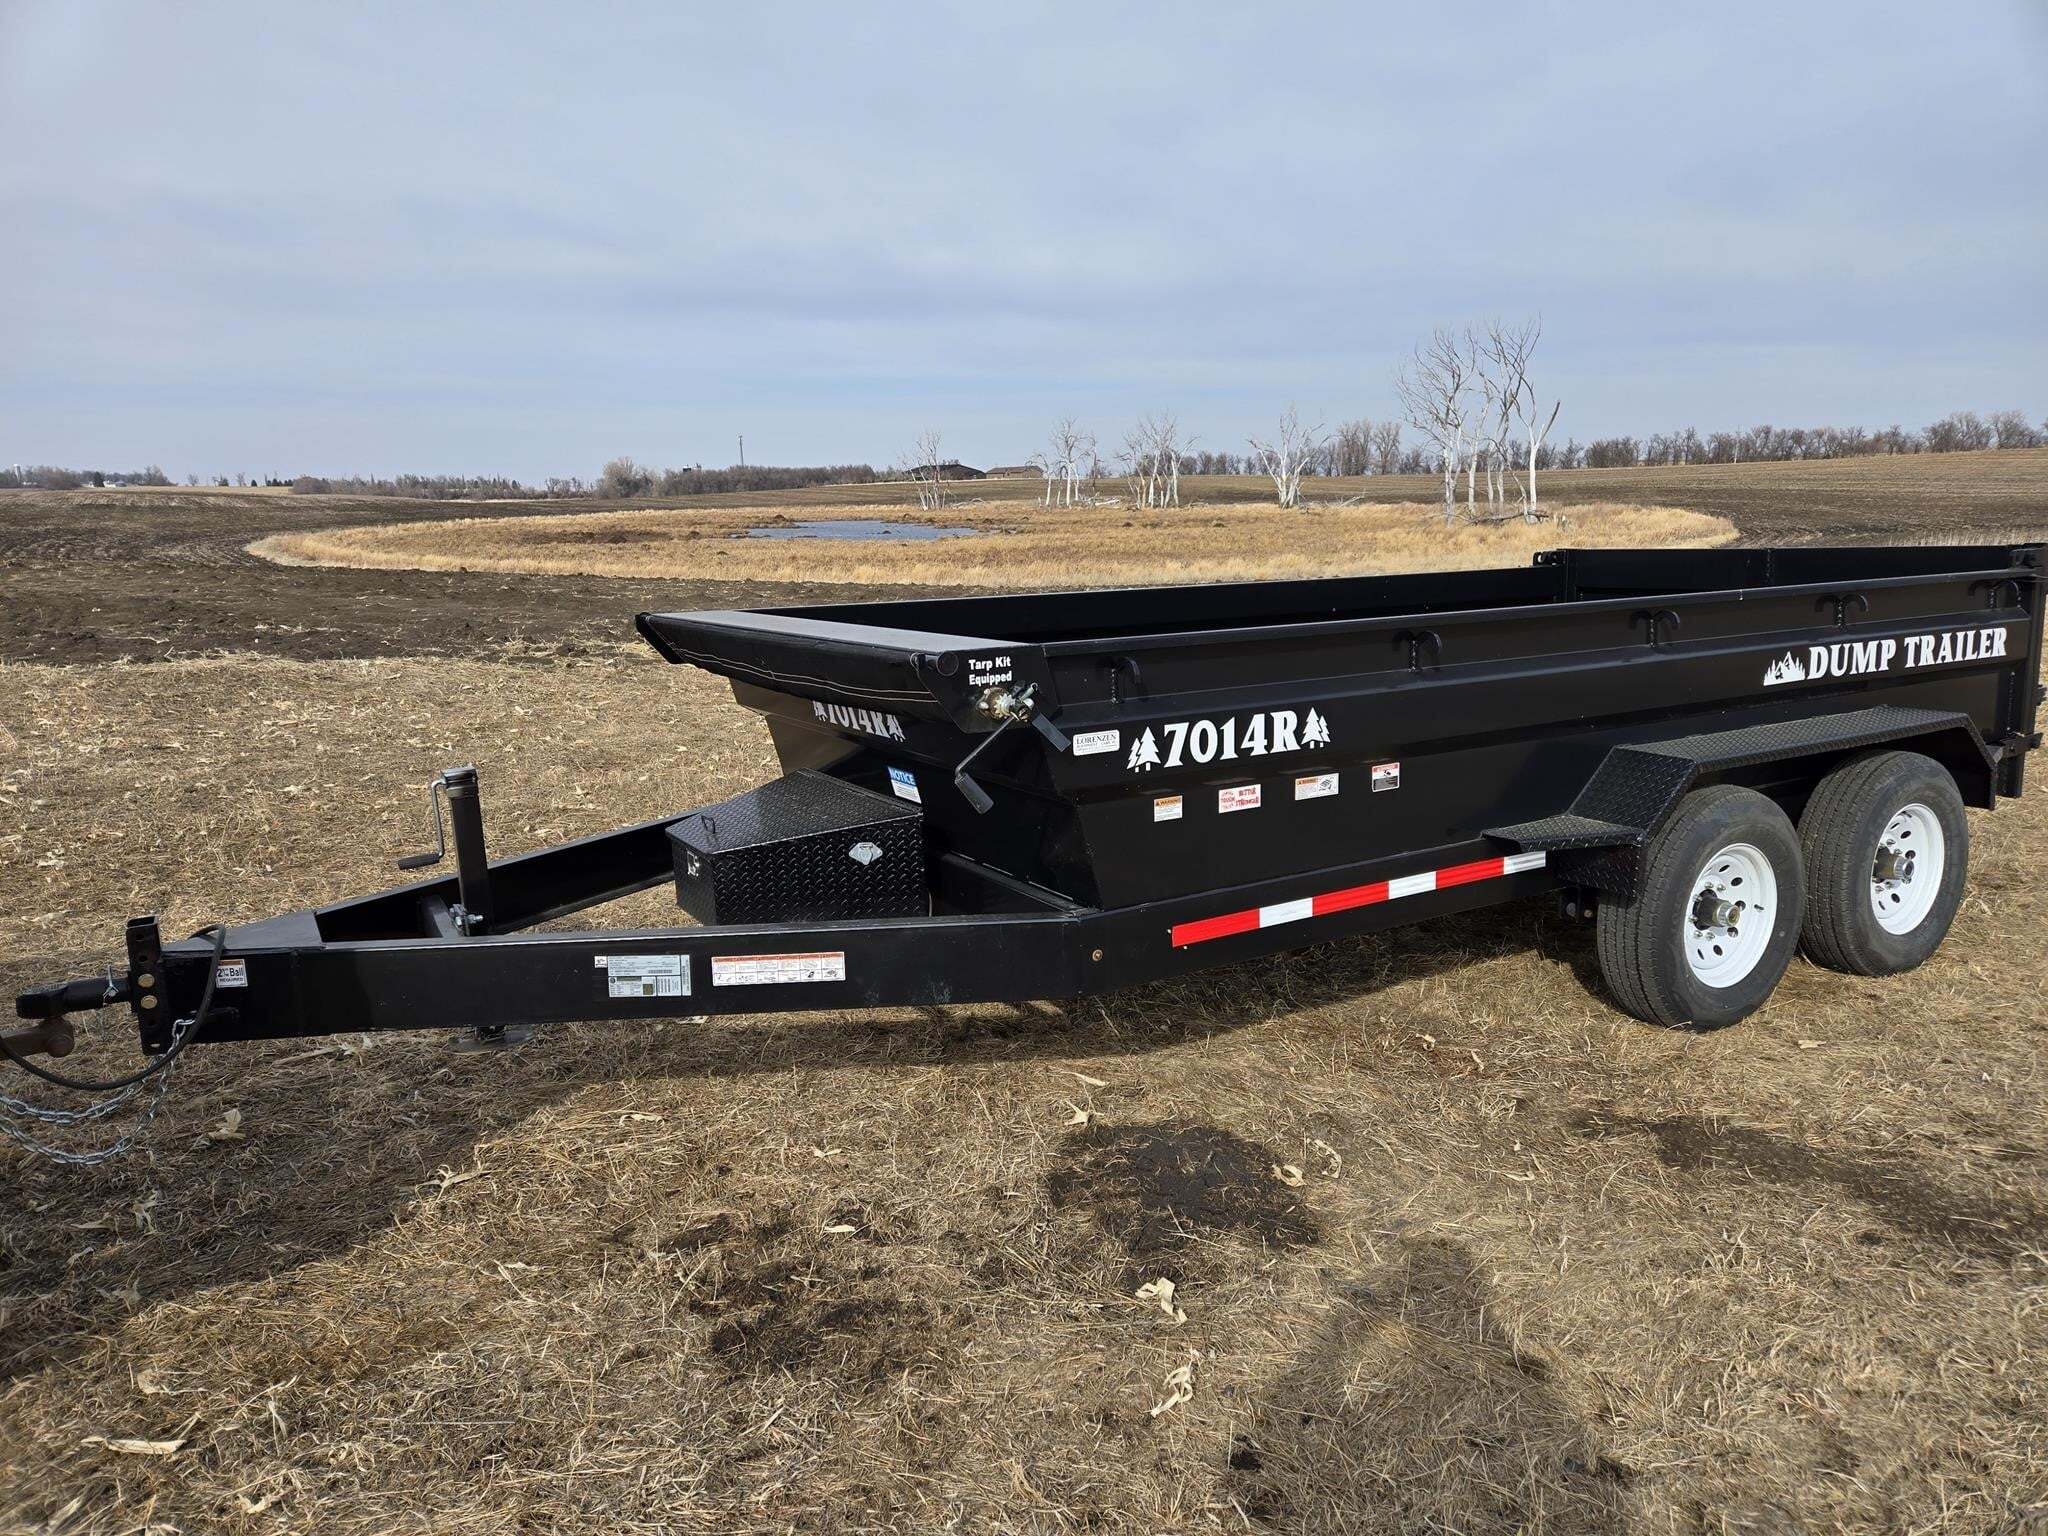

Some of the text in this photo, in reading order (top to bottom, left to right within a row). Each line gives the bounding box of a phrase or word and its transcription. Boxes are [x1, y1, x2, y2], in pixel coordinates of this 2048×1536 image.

[1805, 627, 2008, 680] DUMP TRAILER
[968, 656, 1012, 671] Tarp Kit
[968, 670, 1013, 686] Equipped
[1163, 709, 1301, 768] 7014R
[890, 767, 916, 785] NOTICE
[229, 967, 243, 977] Ball
